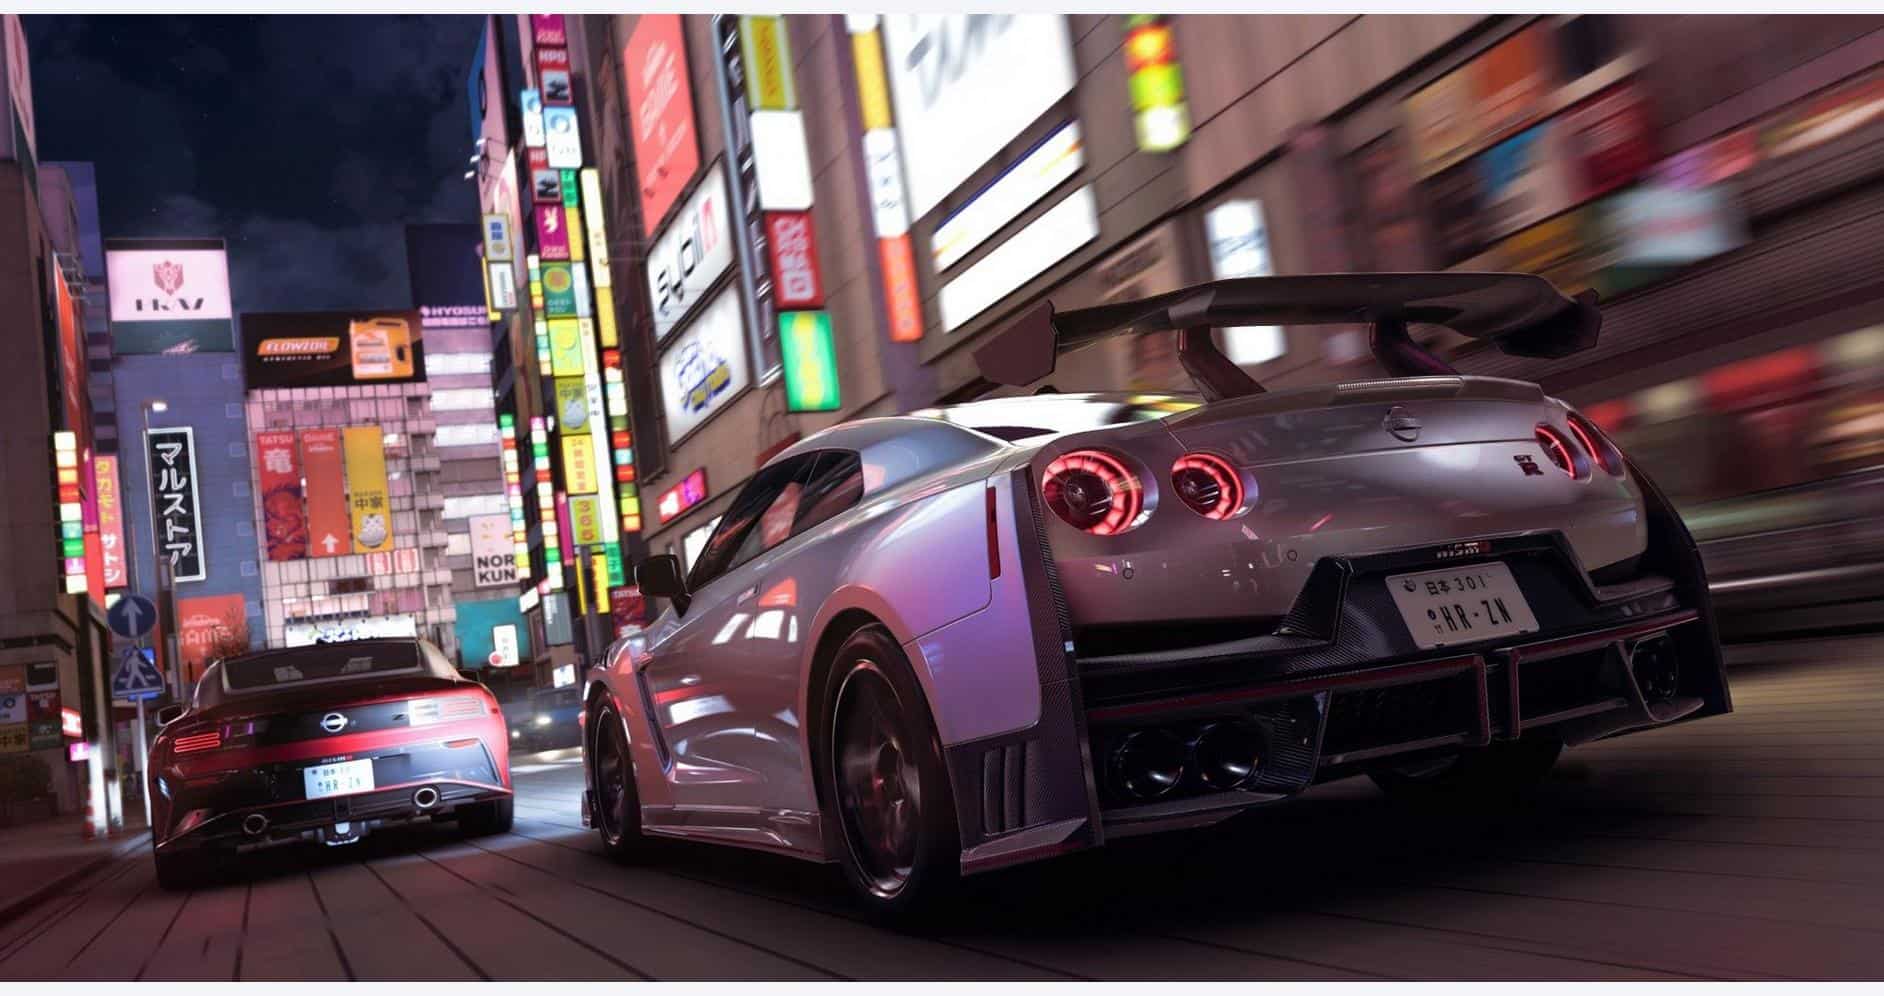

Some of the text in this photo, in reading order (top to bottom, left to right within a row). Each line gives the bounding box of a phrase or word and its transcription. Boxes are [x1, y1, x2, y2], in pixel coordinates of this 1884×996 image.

[259, 434, 294, 445] TATSU
[156, 442, 192, 566] マルストア
[479, 569, 517, 584] KUN
[1454, 575, 1487, 593] 301
[1439, 597, 1513, 633] HR-ZN
